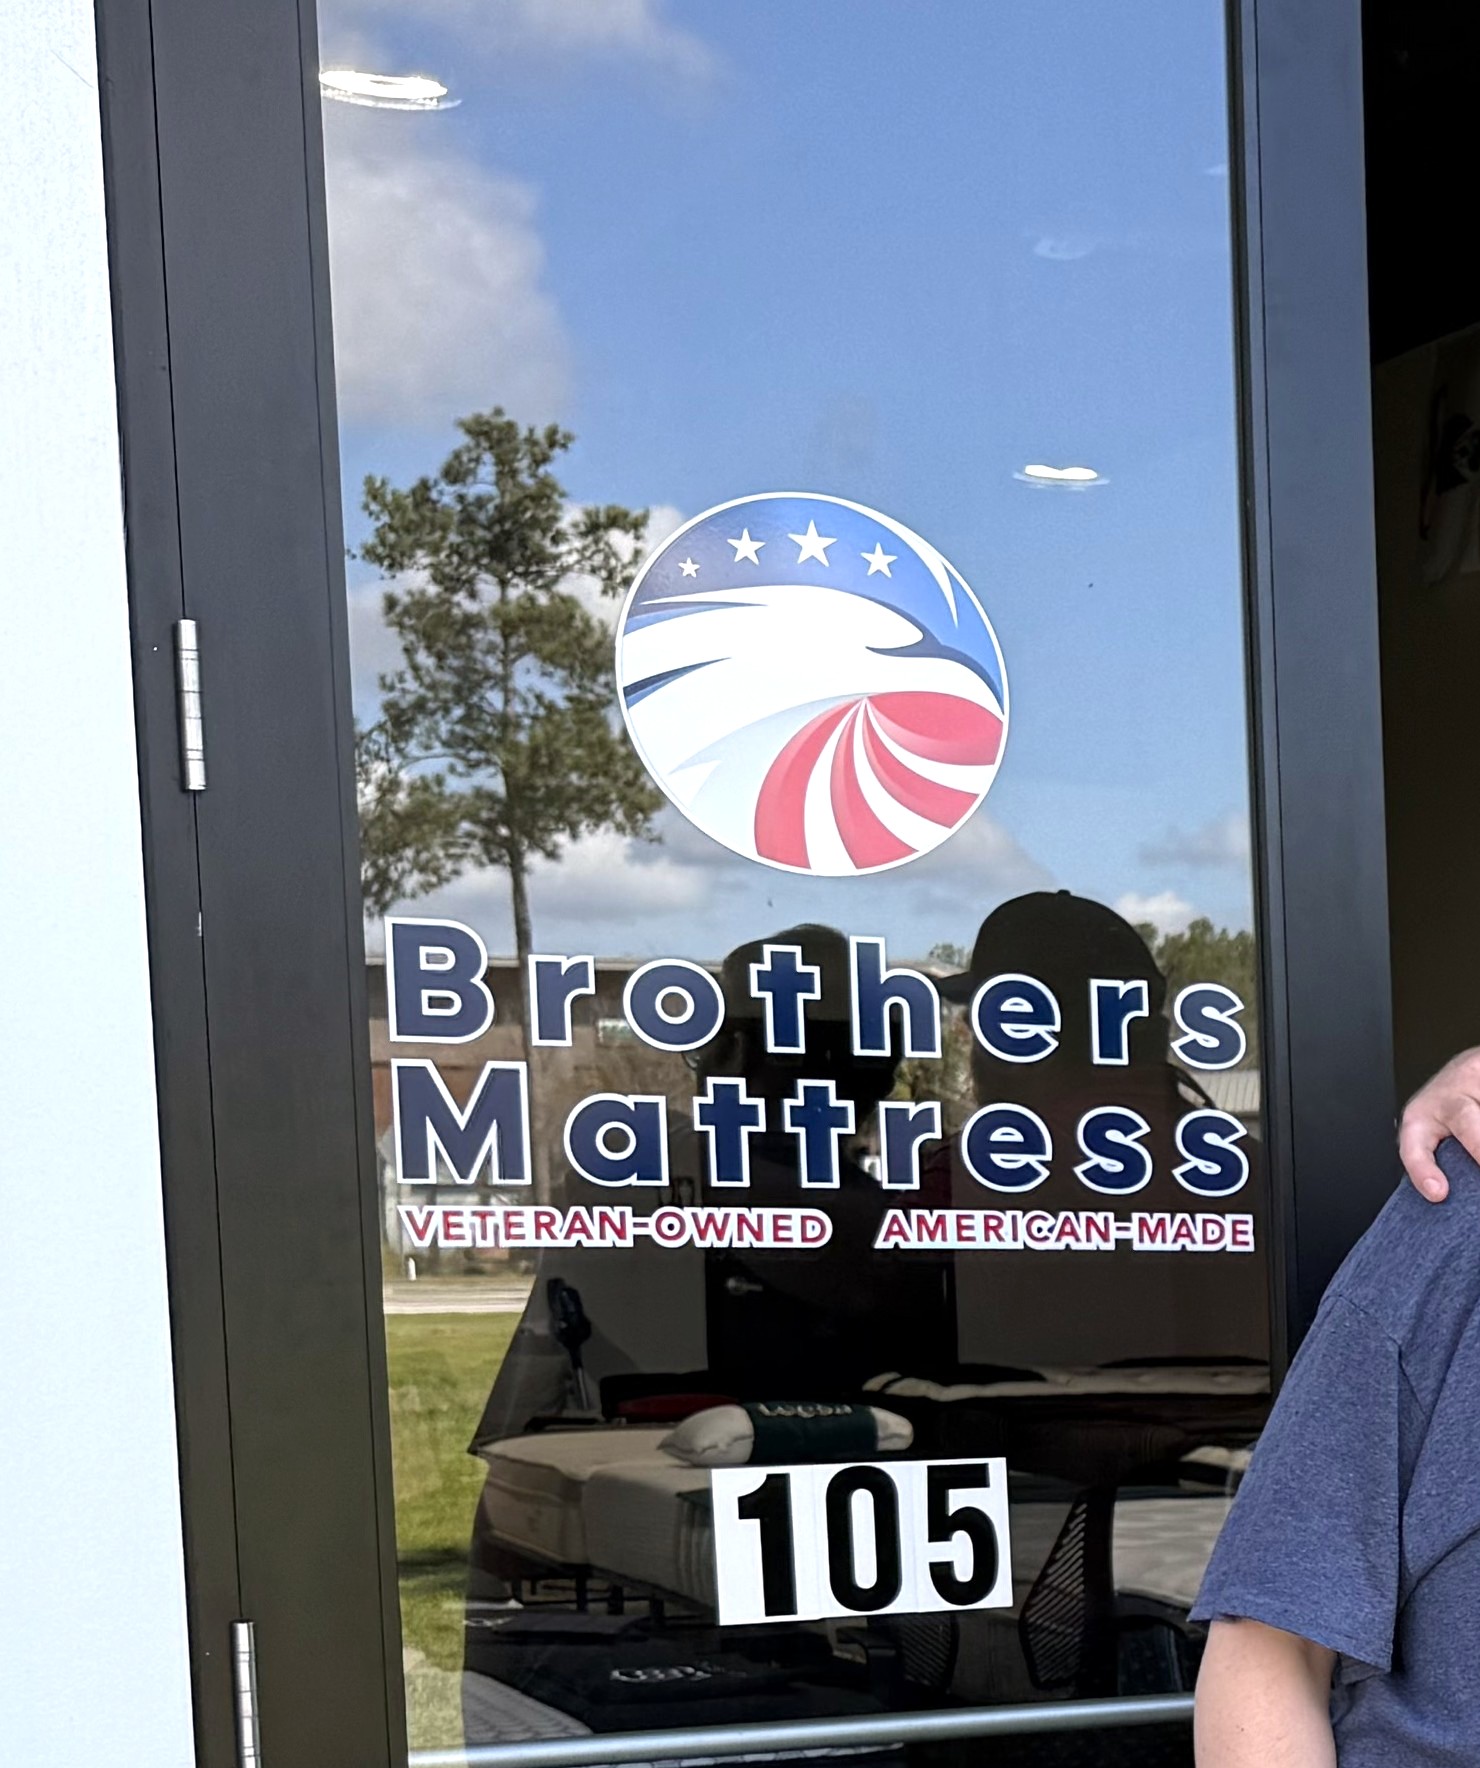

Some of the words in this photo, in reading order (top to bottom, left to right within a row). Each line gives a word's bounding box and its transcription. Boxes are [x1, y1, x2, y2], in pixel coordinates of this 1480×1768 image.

[385, 916, 1247, 1071] Brothers
[390, 1058, 1254, 1196] Mattress
[398, 1206, 833, 1248] VETERAN-OWNED
[873, 1209, 1255, 1252] AMERICAN-MADE
[737, 1462, 1000, 1618] 105
